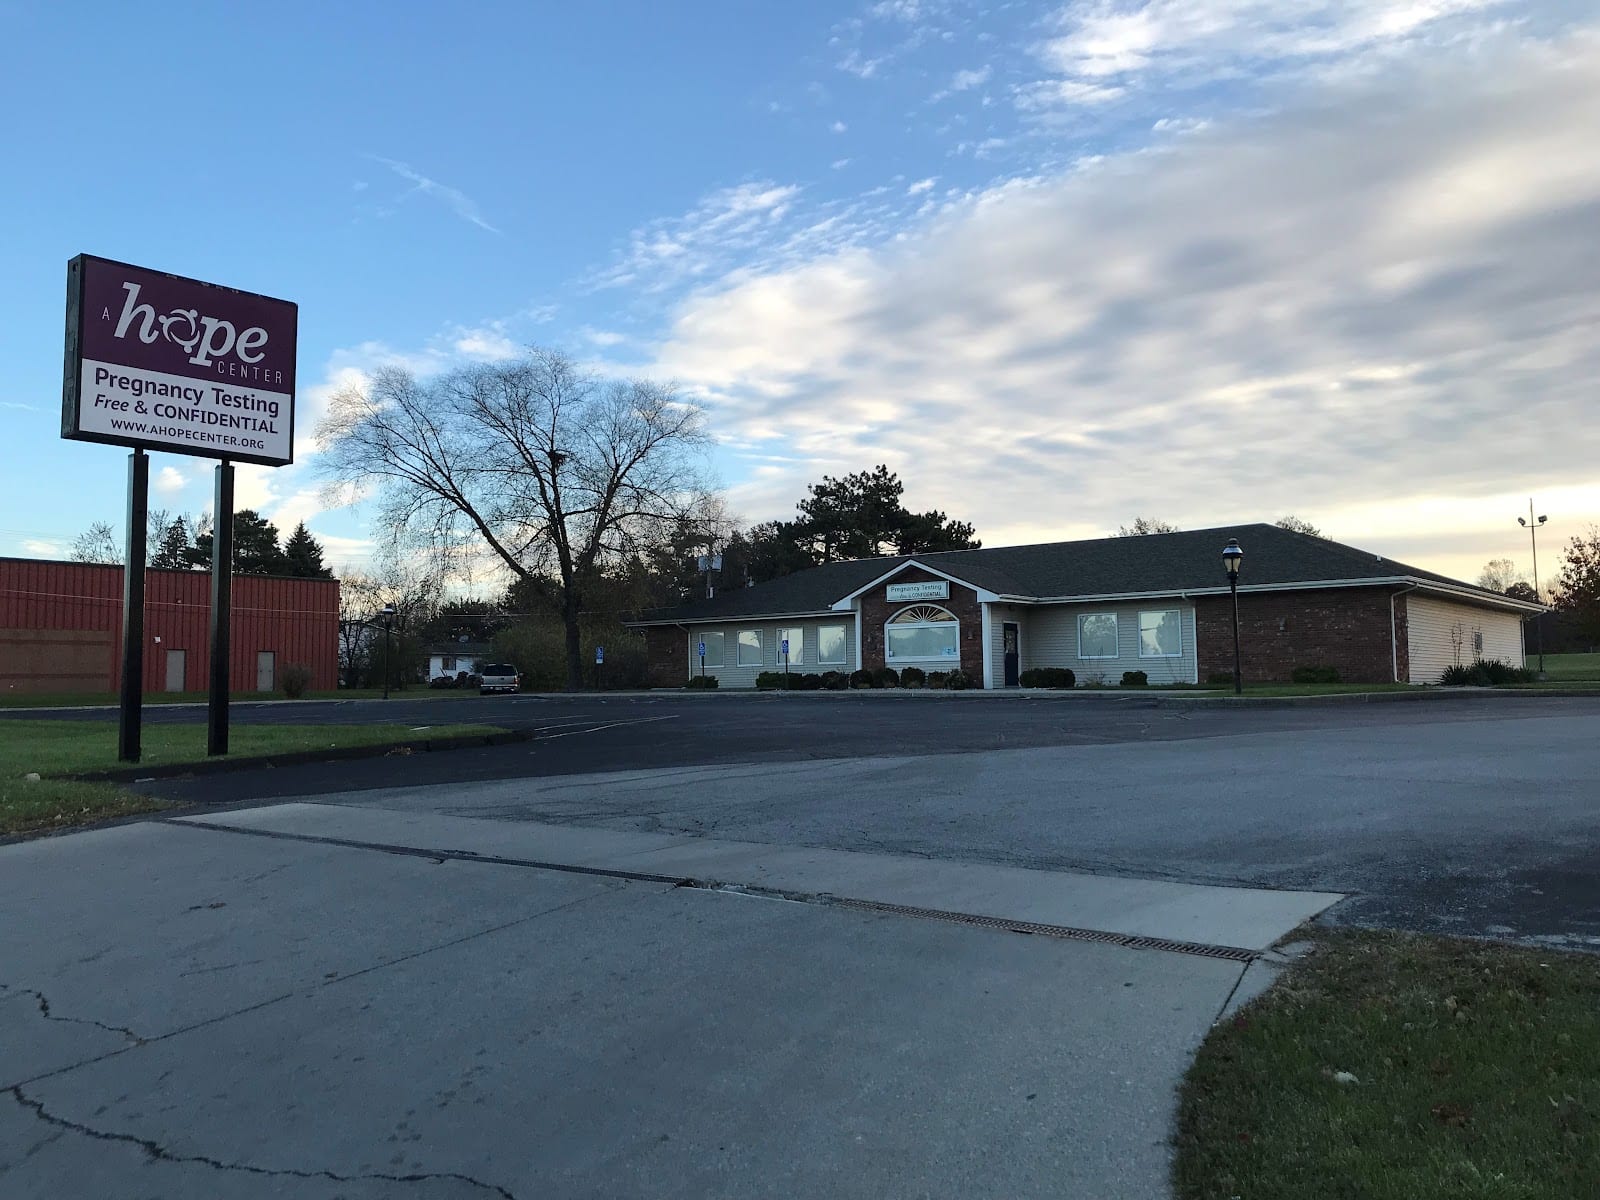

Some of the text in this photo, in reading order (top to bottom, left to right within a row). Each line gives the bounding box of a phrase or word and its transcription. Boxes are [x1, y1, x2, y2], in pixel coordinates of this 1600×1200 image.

[102, 282, 269, 366] A hope
[217, 361, 283, 384] CENTER
[95, 370, 279, 417] Pregnancy Testing
[94, 394, 278, 434] Free & CONFIDENTIAL
[111, 418, 265, 450] WWW.AHOPECENTER.ORG
